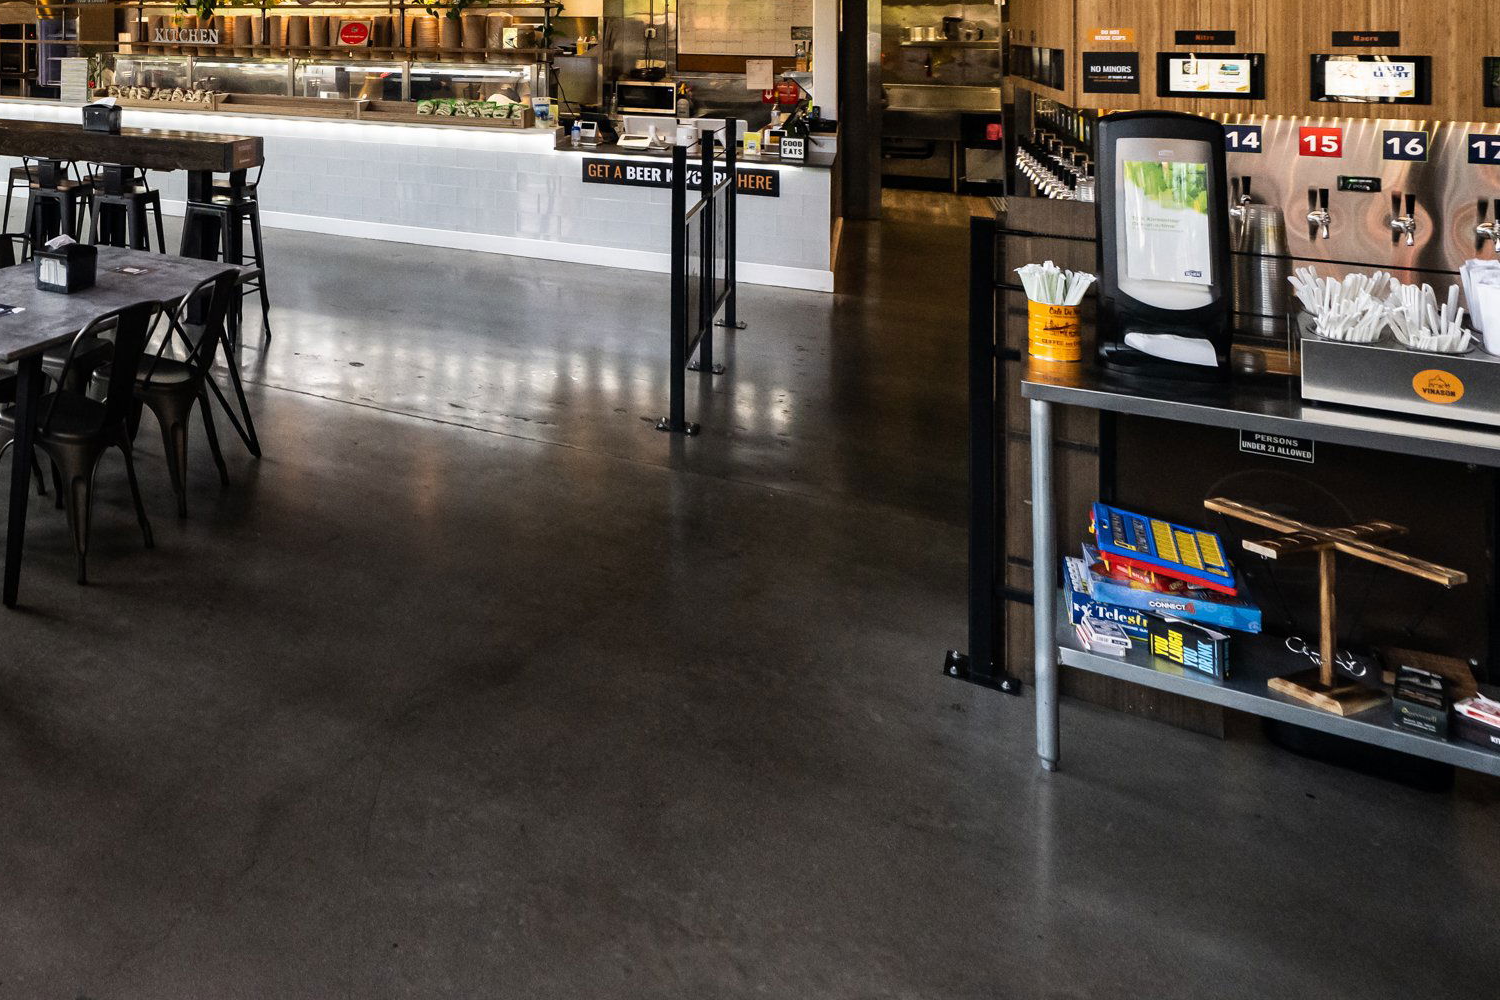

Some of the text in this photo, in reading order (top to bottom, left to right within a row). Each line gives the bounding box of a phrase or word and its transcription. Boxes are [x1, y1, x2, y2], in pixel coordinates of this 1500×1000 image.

[155, 27, 220, 44] KITCHEN
[1352, 34, 1379, 42] Macro
[1090, 65, 1132, 73] NO MINORS
[782, 140, 803, 148] GOOD
[1225, 131, 1260, 149] 14
[1303, 135, 1339, 153] 15
[1386, 137, 1424, 156] 16
[782, 147, 803, 156] EATS
[588, 163, 611, 178] GET
[613, 165, 622, 179] A
[626, 166, 661, 182] BEER
[737, 174, 773, 191] HERE
[1422, 387, 1456, 397] VINASON
[1255, 433, 1298, 447] PERSONS
[1241, 440, 1312, 459] UNDER 21 ALLOWED
[1149, 600, 1196, 614] CONNECT 4
[1154, 629, 1213, 675] YOU LAUGH YOU DRINK
